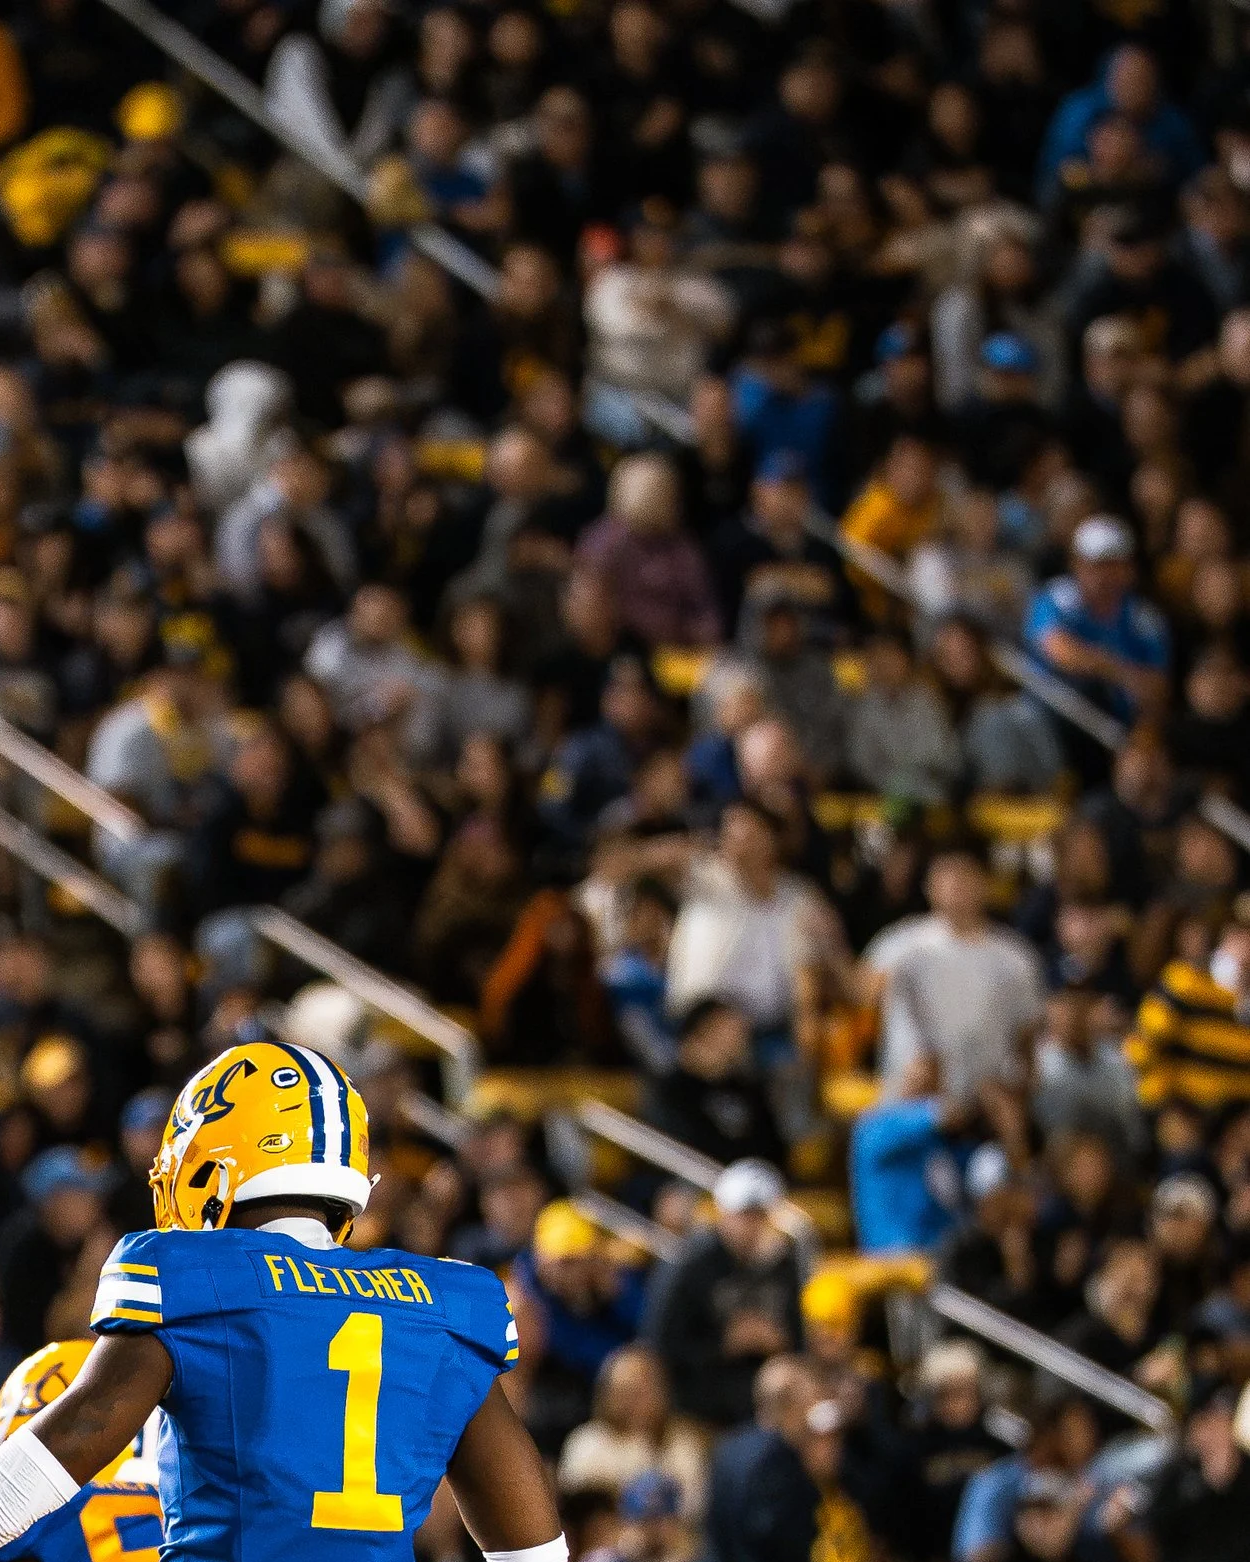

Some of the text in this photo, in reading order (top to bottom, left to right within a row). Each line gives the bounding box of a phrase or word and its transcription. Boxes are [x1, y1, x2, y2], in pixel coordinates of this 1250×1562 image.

[272, 1069, 299, 1088] C
[263, 1254, 434, 1306] FLETCHER
[311, 1312, 404, 1532] 1
